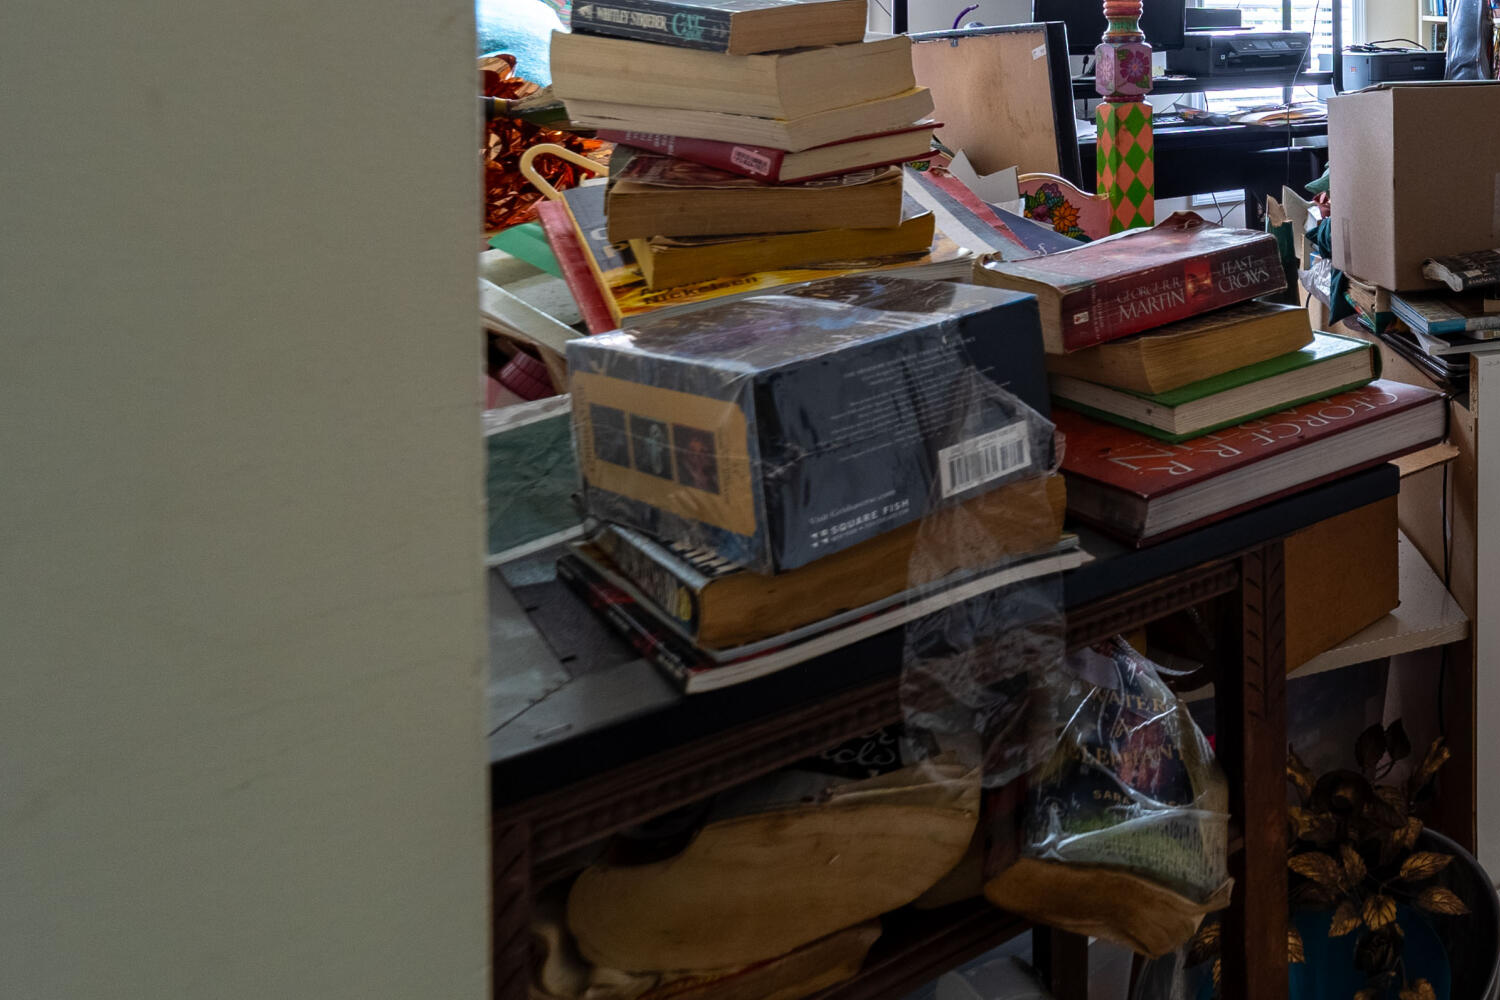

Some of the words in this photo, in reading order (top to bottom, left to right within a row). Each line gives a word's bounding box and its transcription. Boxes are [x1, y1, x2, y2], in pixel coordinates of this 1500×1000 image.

[644, 276, 758, 305] Nickelsen
[1217, 266, 1270, 294] CROWS
[1118, 291, 1186, 324] MARTIN
[1247, 391, 1400, 449] GEORGE
[830, 510, 878, 535] SQUARE
[882, 498, 910, 516] FISH
